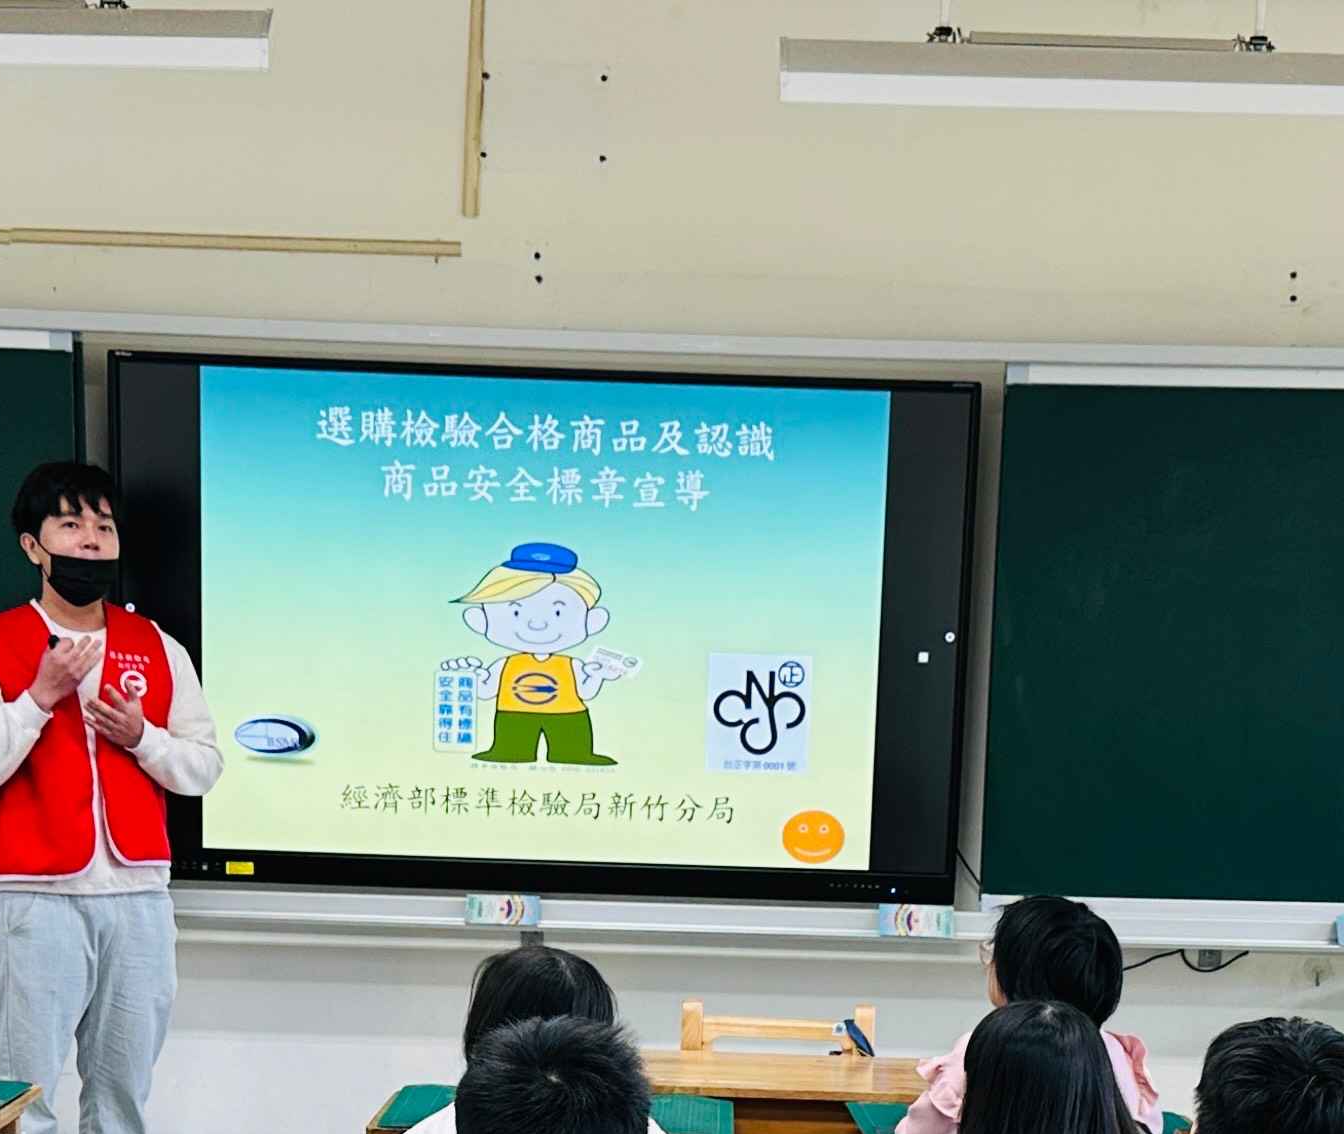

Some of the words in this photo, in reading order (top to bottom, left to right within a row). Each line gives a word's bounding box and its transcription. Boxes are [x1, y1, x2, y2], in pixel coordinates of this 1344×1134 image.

[316, 405, 776, 462] 選購檢驗合格商品及認識
[381, 460, 711, 513] 商品安全標章宣導
[340, 783, 735, 825] 經濟部標準檢驗局新竹分局
